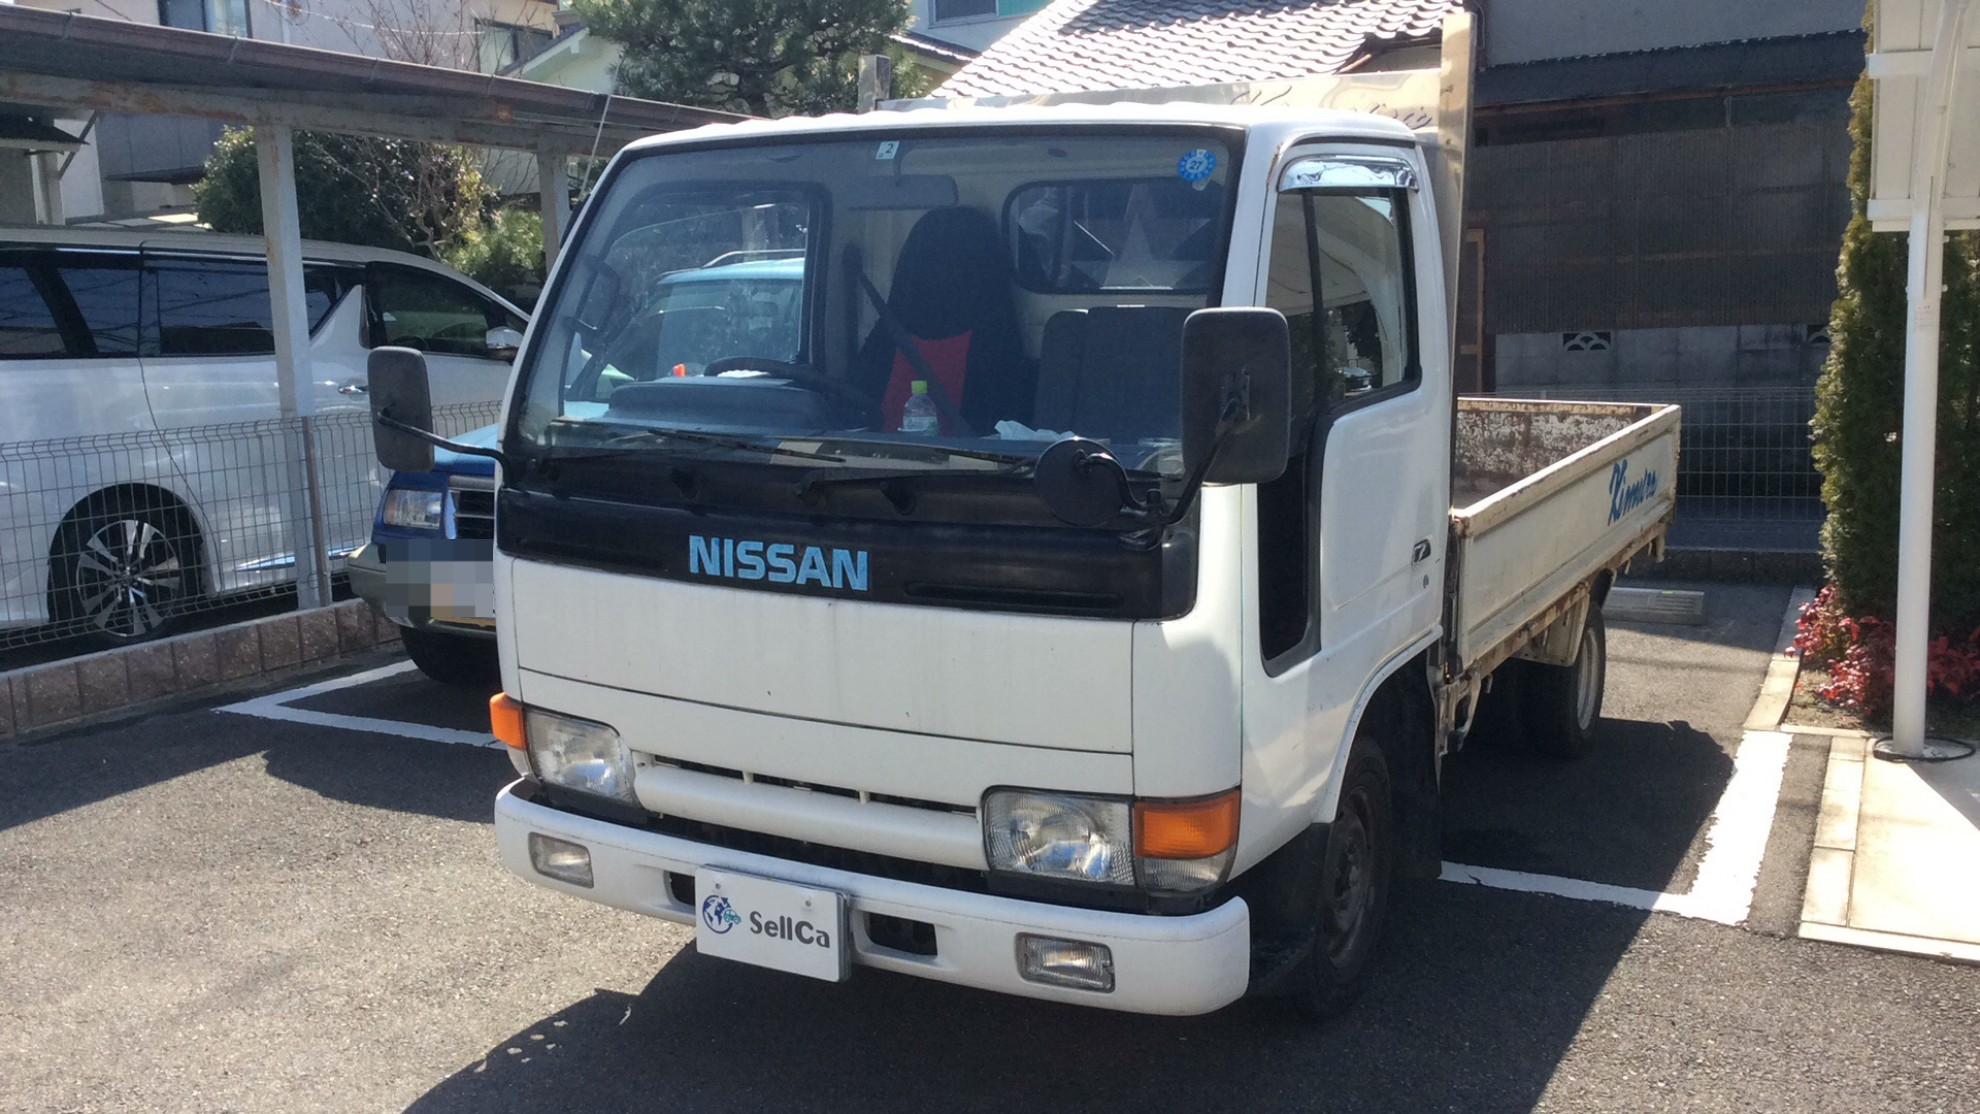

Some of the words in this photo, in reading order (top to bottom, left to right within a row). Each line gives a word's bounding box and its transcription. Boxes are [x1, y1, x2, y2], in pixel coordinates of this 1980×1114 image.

[885, 143, 894, 154] 2
[1189, 160, 1204, 171] 27
[689, 535, 868, 591] NISSAN
[749, 910, 831, 949] SellCa
